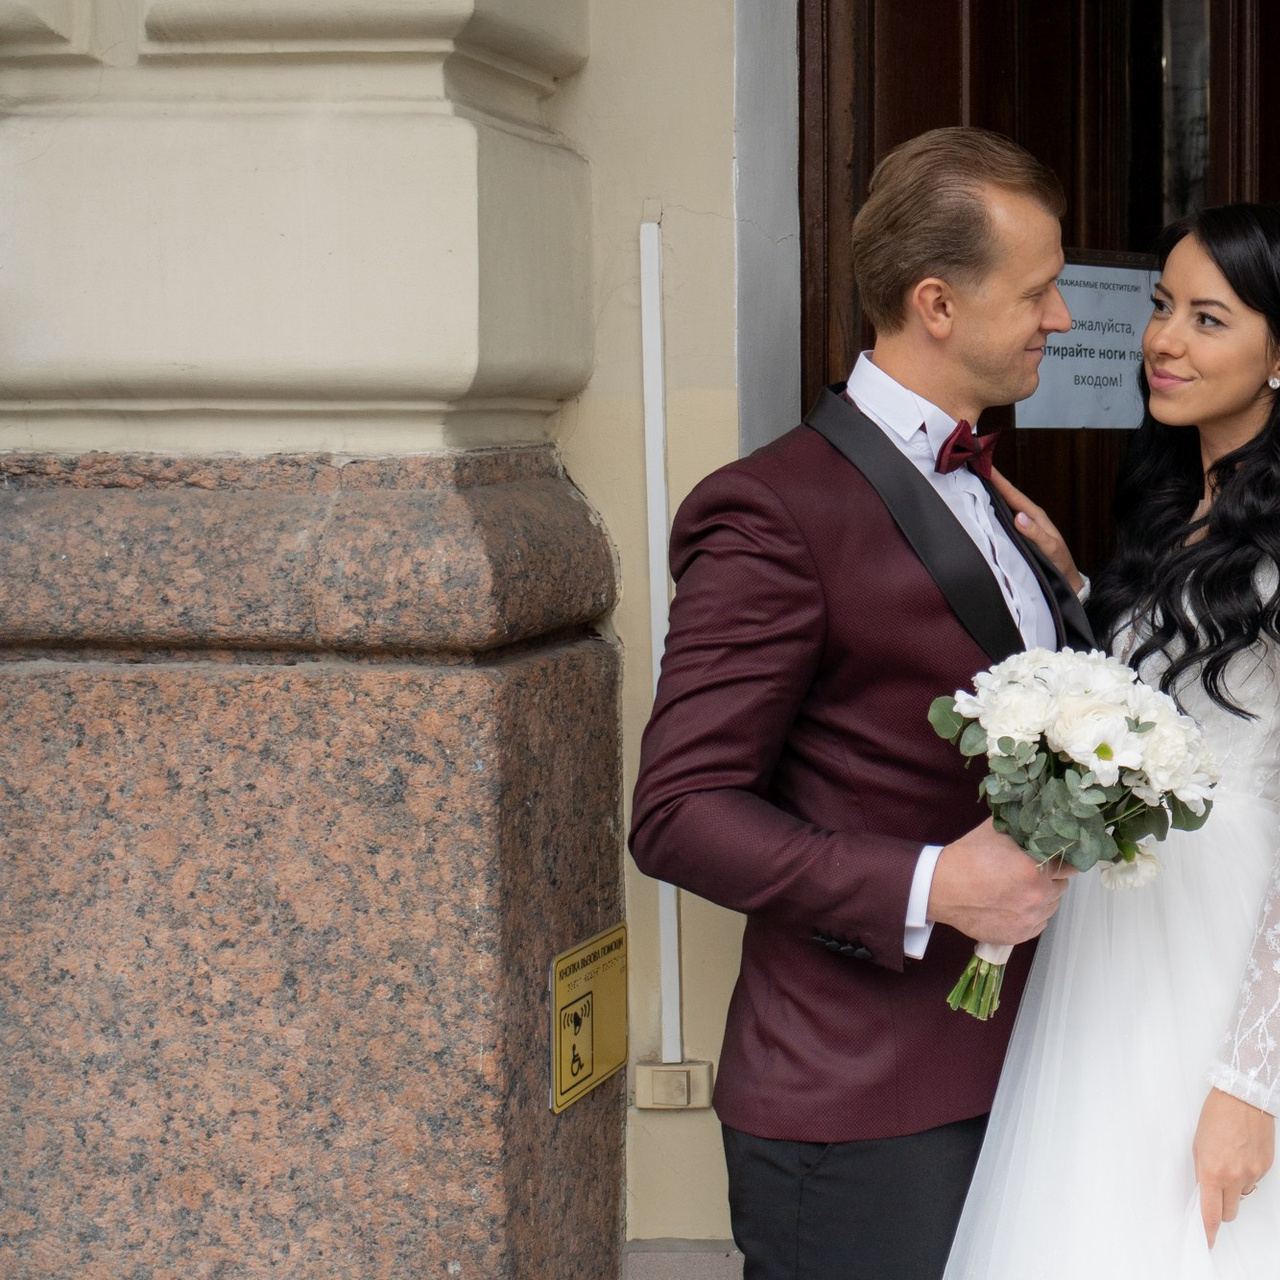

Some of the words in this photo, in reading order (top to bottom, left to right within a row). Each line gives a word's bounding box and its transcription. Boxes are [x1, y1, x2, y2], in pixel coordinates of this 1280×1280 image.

[1056, 279, 1098, 289] УВАЖАЕМЫЕ
[1100, 282, 1141, 293] ПОСЕТИТЕЛИ!
[1071, 318, 1136, 336] ожалуйста,
[1043, 343, 1096, 360] тирайте
[1098, 348, 1126, 361] ноги
[1074, 373, 1123, 389] входом!
